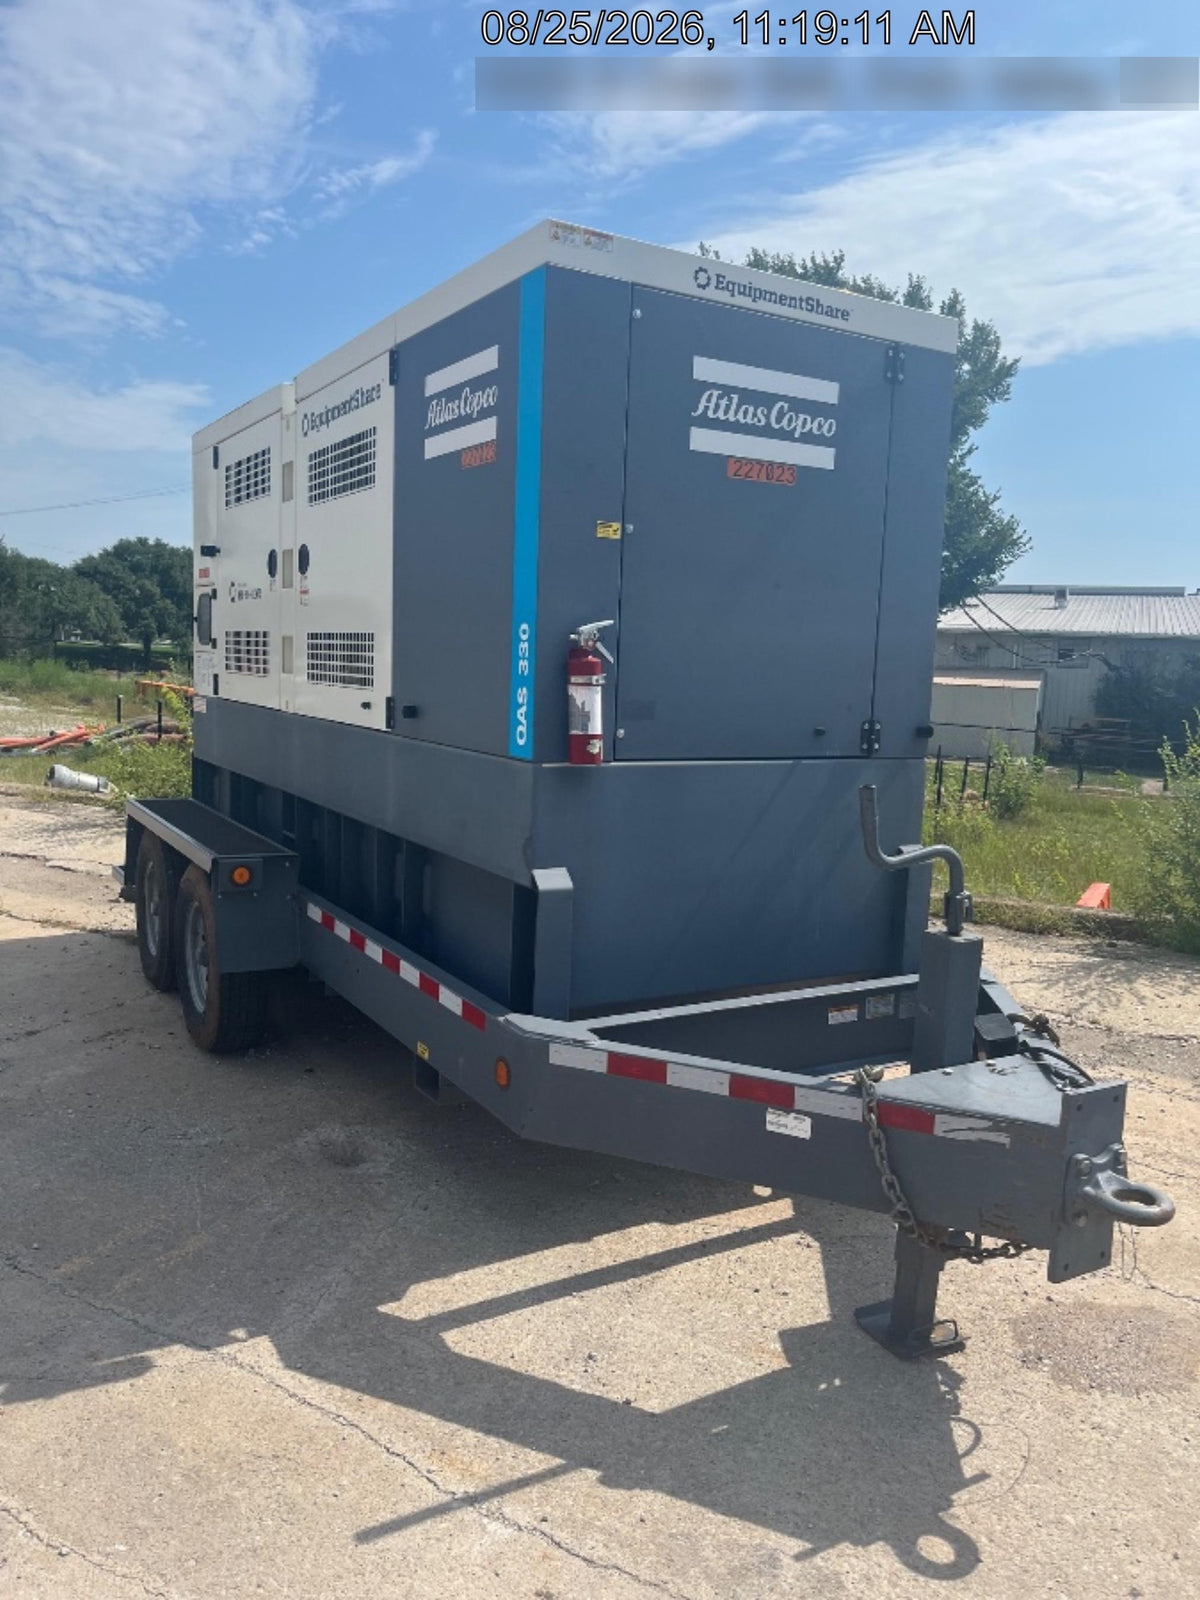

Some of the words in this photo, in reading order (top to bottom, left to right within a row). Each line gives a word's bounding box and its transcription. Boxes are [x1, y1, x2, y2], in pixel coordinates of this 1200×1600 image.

[714, 273, 850, 322] EquipmentShare
[424, 397, 460, 430] Atlas
[460, 385, 498, 419] Copco
[691, 389, 767, 426] Atlas
[770, 401, 836, 438] Copco
[733, 460, 797, 484] 227023
[518, 622, 529, 676] 330
